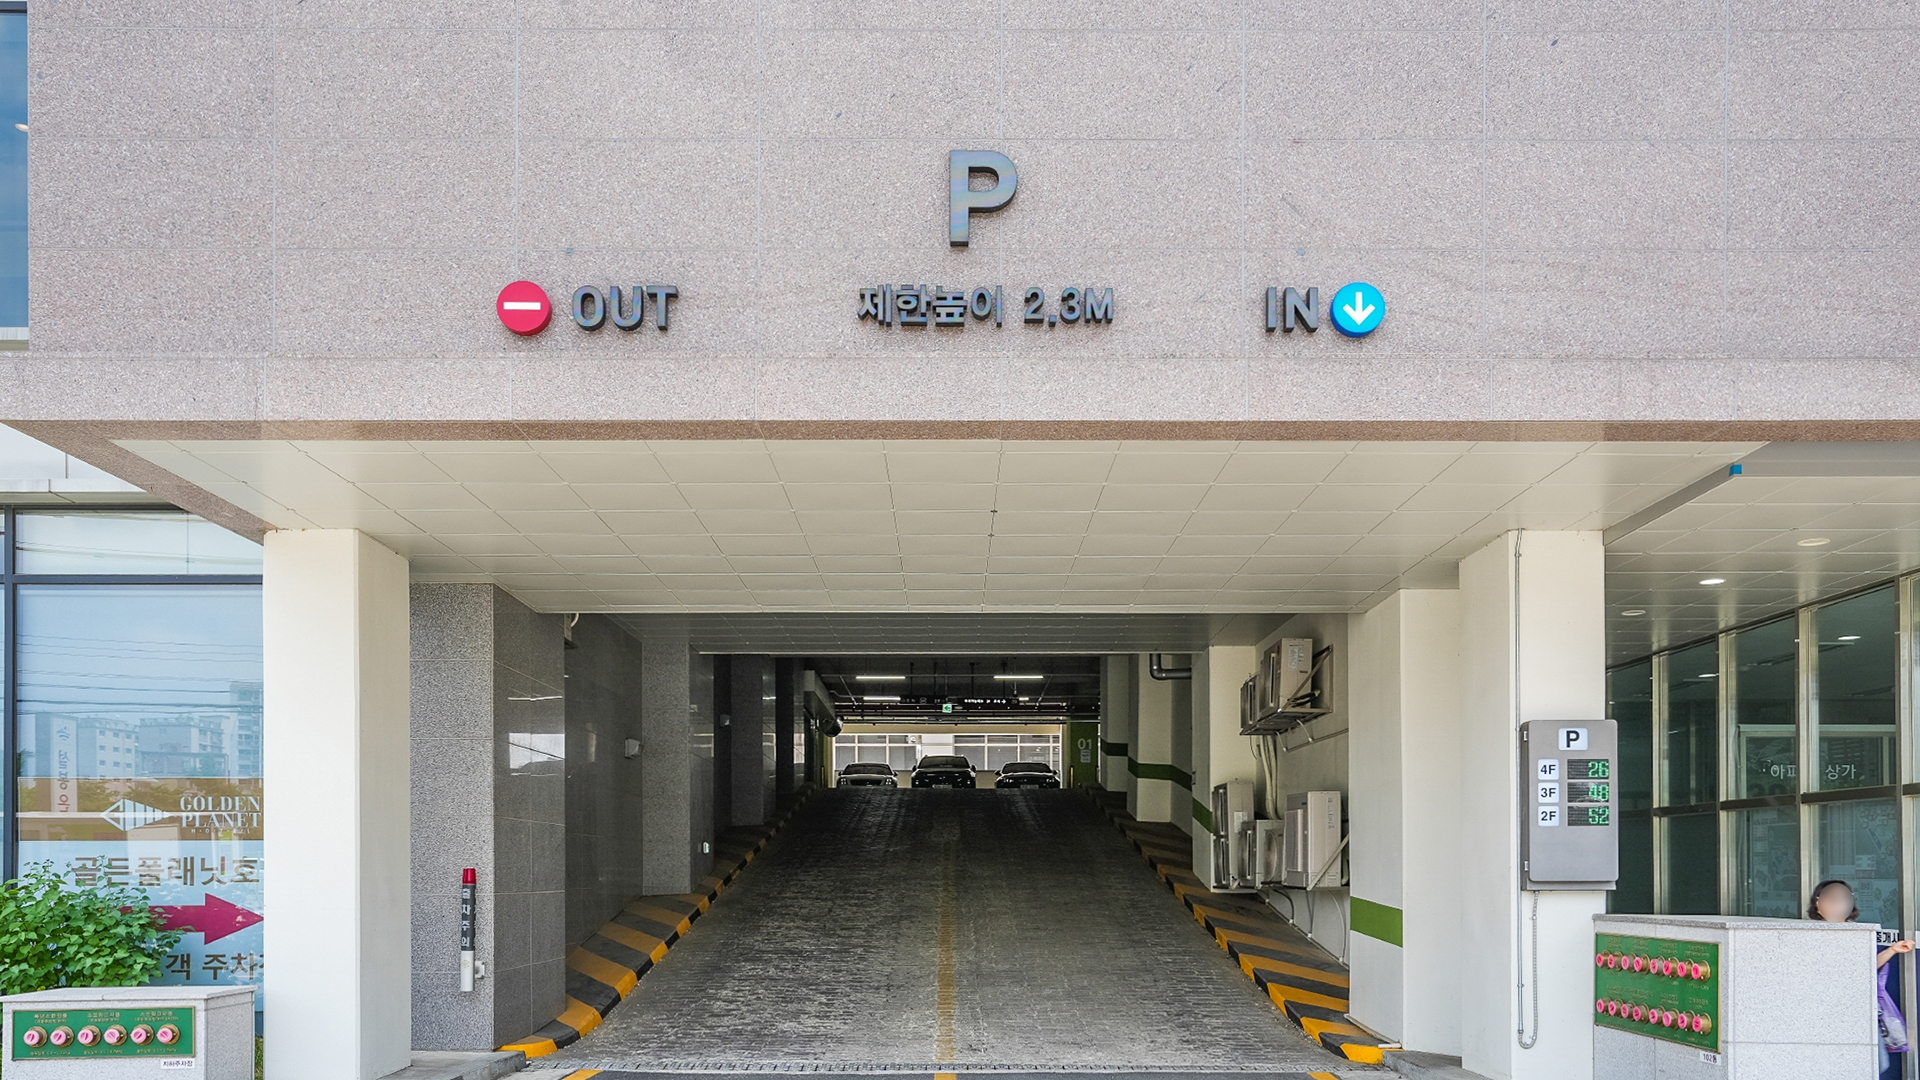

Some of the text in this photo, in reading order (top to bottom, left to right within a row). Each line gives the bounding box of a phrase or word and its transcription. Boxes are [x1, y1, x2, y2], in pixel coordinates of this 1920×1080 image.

[948, 149, 1018, 248] P
[571, 284, 678, 332] OUT
[857, 285, 1115, 328] 제한높이 2.3M
[1264, 286, 1319, 334] IN
[1077, 738, 1092, 750] 01
[1566, 730, 1580, 748] P
[1540, 764, 1556, 775] 4F
[1588, 761, 1609, 778] 26
[1825, 764, 1857, 780] 상가
[1540, 787, 1556, 798] 3F
[1588, 784, 1609, 801] 48
[180, 796, 261, 811] GOLDEN
[181, 812, 262, 828] PLANET
[1540, 810, 1557, 821] 2F
[1588, 807, 1609, 824] 52
[202, 953, 264, 981] 주차
